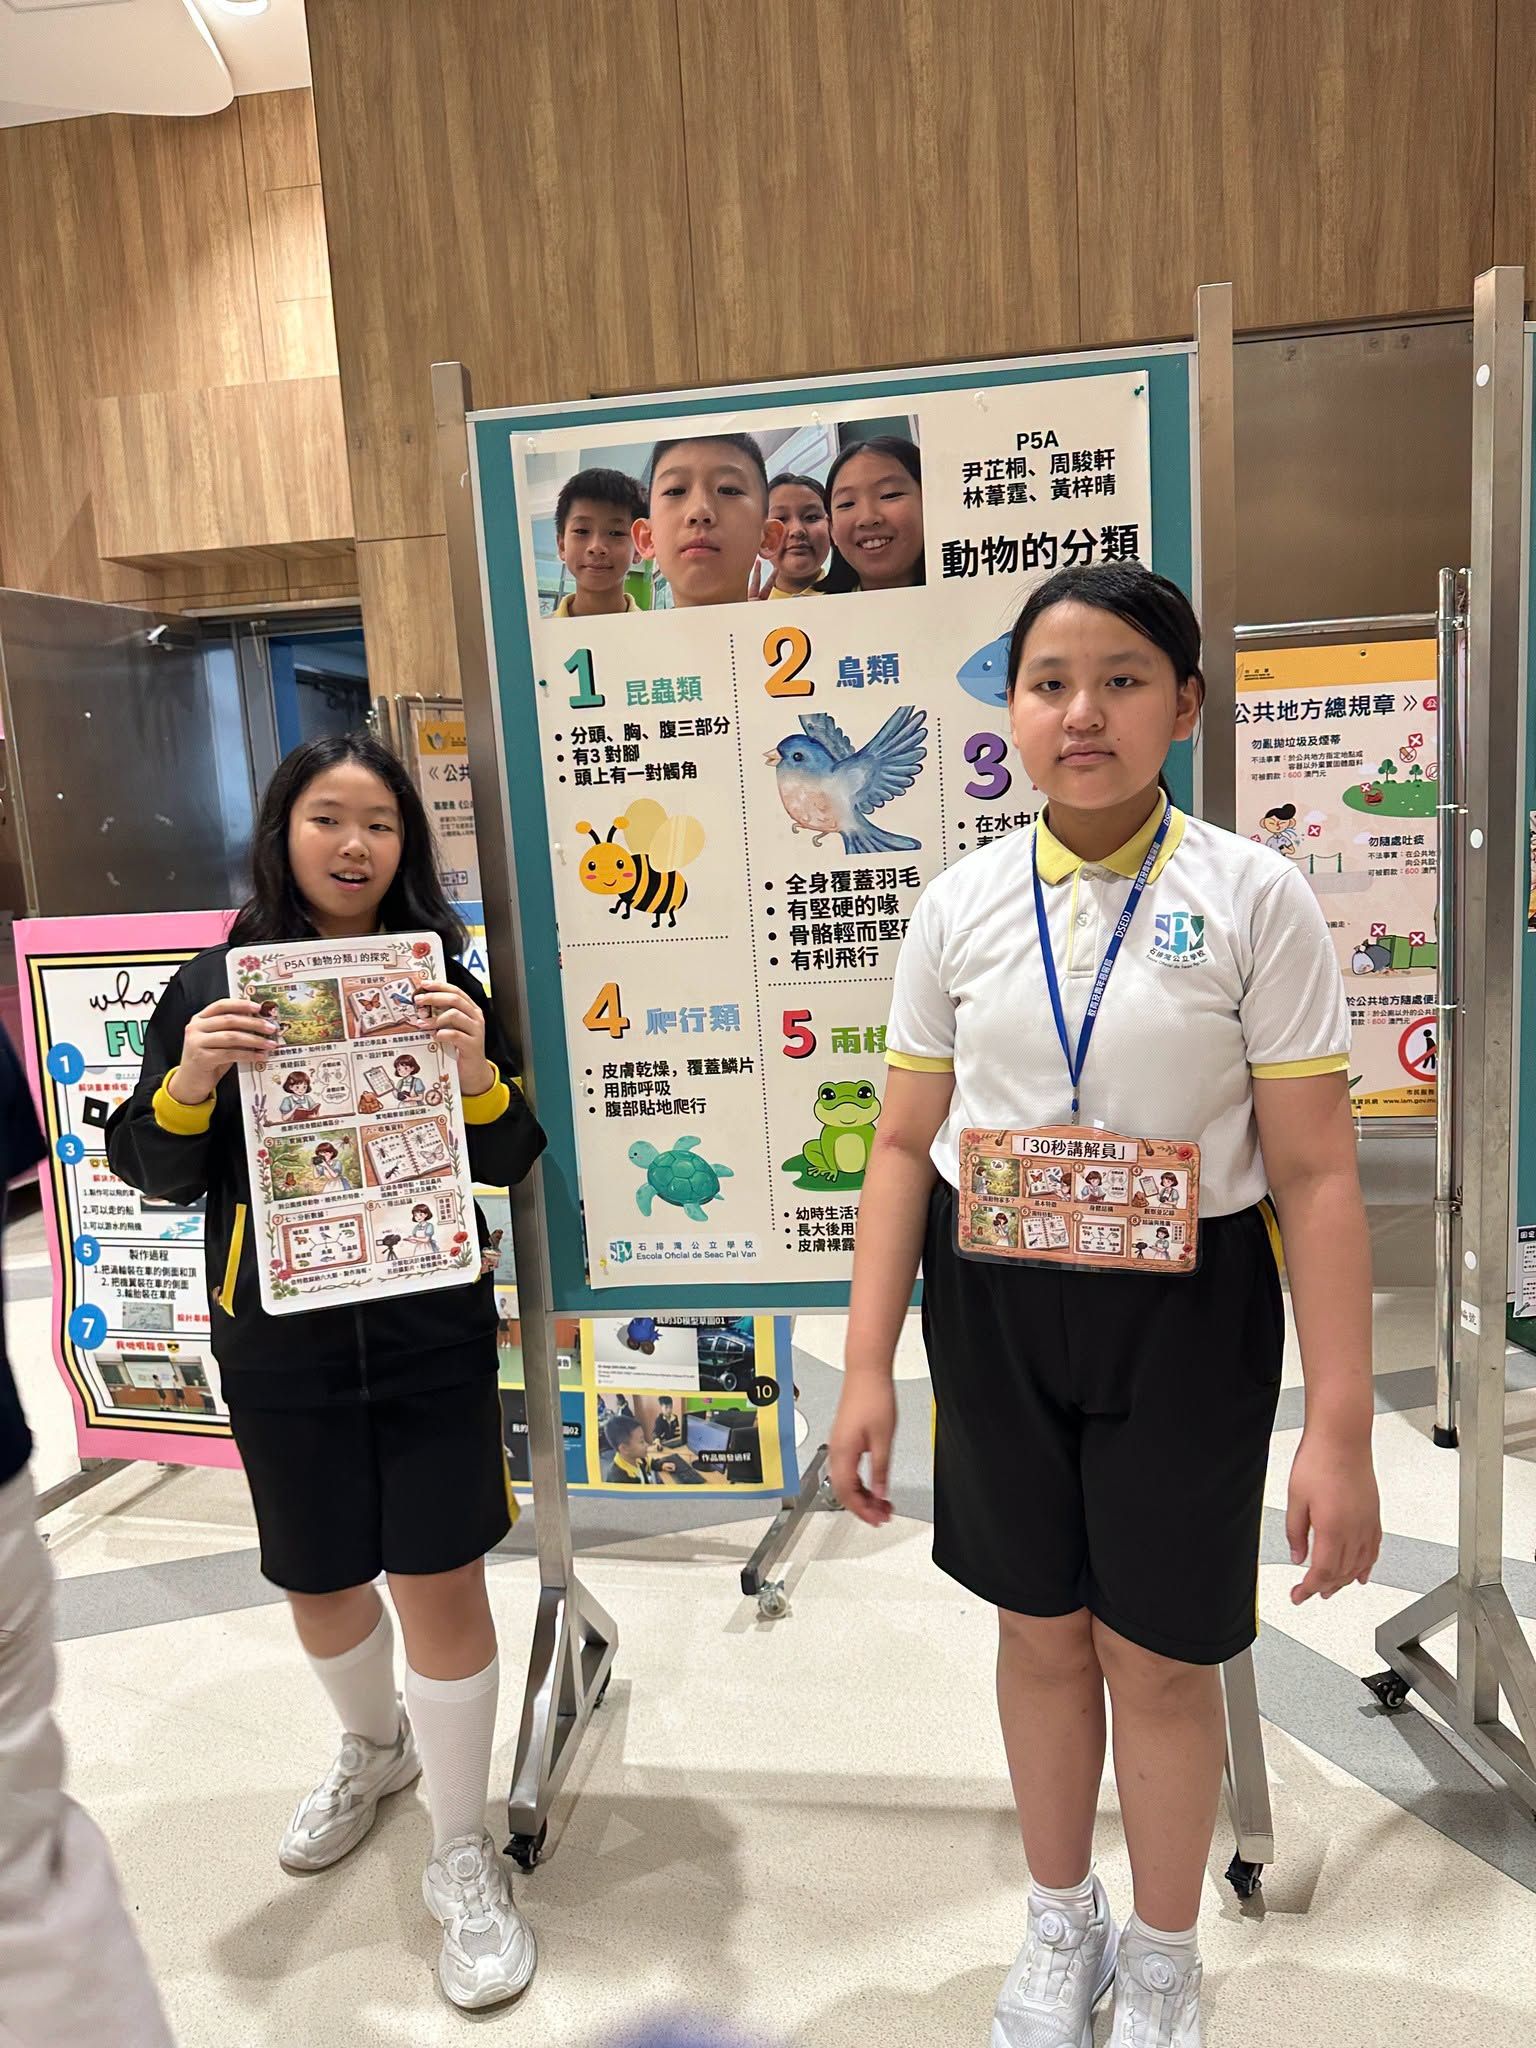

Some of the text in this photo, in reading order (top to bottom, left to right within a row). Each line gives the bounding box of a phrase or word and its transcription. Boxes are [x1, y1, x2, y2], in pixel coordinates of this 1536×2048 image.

[1017, 430, 1059, 450] P5A
[941, 524, 1140, 580] 動物的分類
[763, 626, 815, 698] 2
[836, 652, 900, 689] 鳥類
[564, 648, 605, 709] 1
[626, 676, 703, 706] 昆蟲類
[570, 716, 731, 745] 分頭、胸、腹三部分
[574, 761, 698, 786] 頭上有一對觸角
[963, 732, 1012, 801] 3
[975, 811, 1039, 833] 在水中
[785, 865, 921, 896] 全身覆蓋羽毛
[1115, 910, 1132, 938] DSEDJ
[790, 945, 879, 971] 有利飛行
[583, 982, 630, 1039] 4
[645, 1003, 741, 1036] 爬行類
[783, 1009, 817, 1059] 5
[59, 1055, 70, 1073] 1
[602, 1056, 755, 1080] 皮膚乾燥，覆蓋鱗片
[604, 1080, 672, 1098] 用肺呼吸
[605, 1097, 707, 1118] 腹部貼地爬行
[65, 1142, 75, 1156] 3
[1022, 1137, 1125, 1160] 「30秒講解員」
[83, 1243, 92, 1258] 5
[129, 1248, 169, 1261] 製作過程
[704, 1251, 724, 1259] Seac
[798, 1238, 856, 1252] 皮膚裸露
[82, 1317, 97, 1339] 7
[755, 1385, 773, 1399] 10
